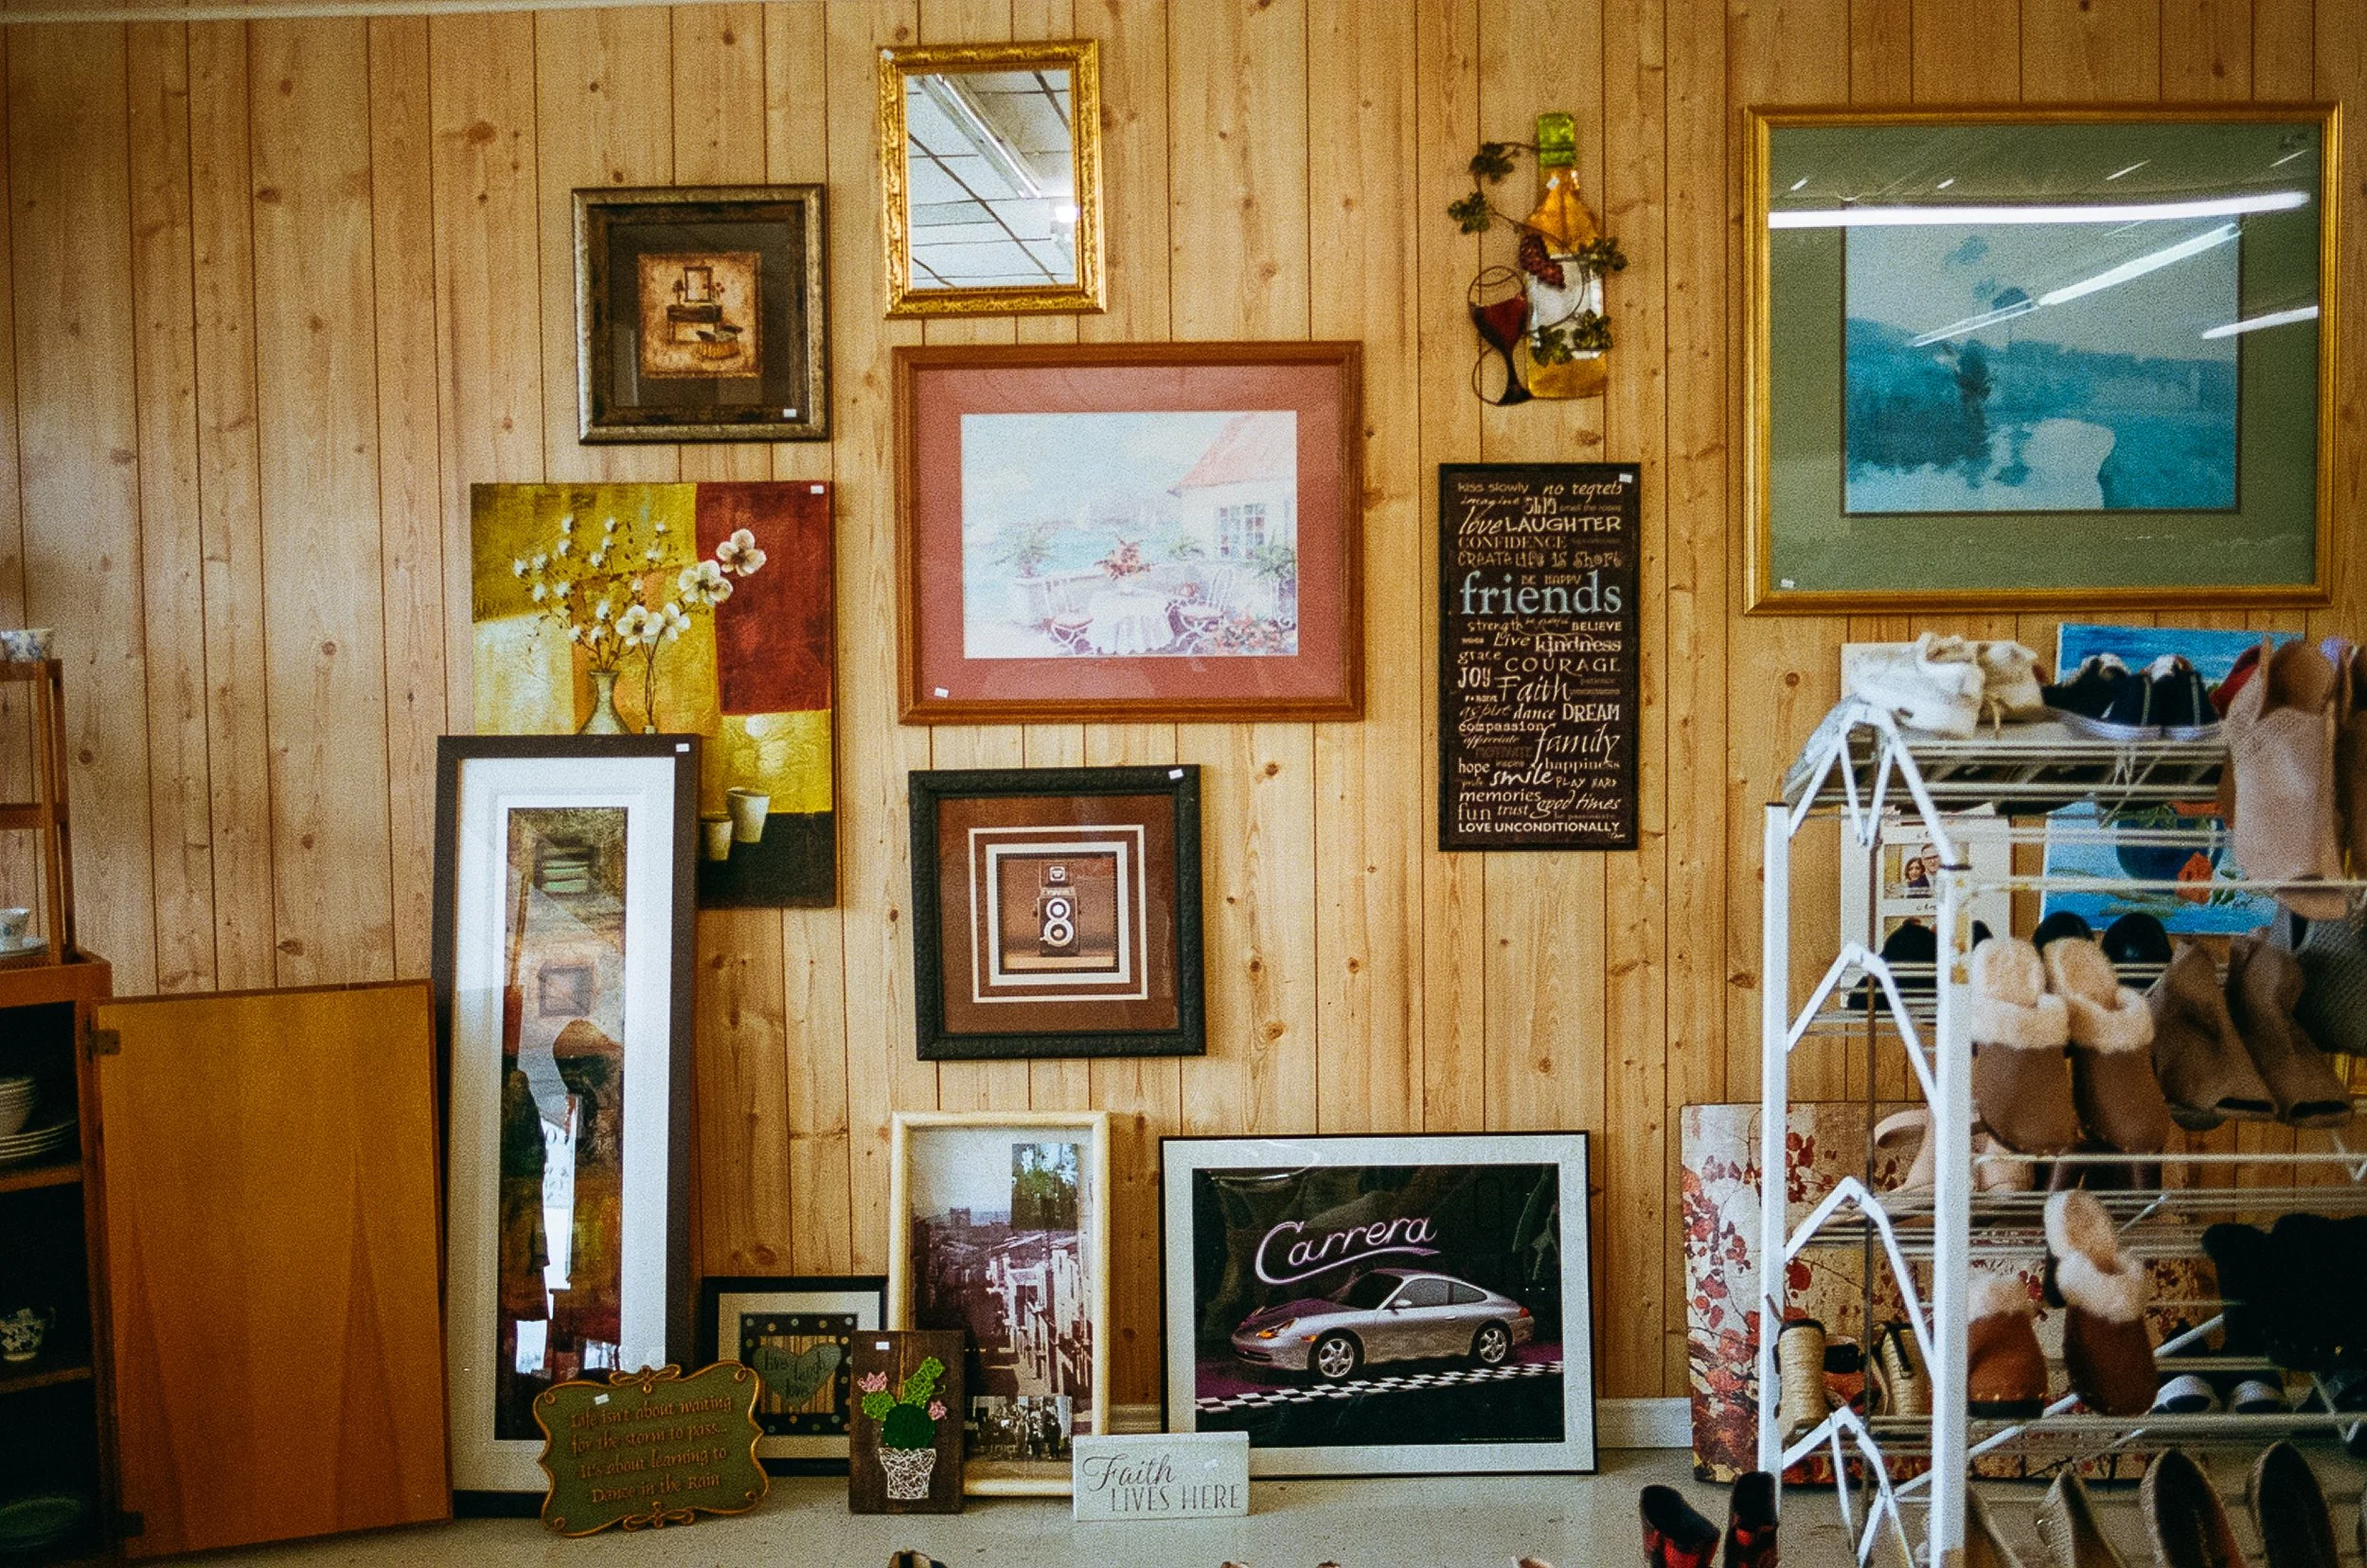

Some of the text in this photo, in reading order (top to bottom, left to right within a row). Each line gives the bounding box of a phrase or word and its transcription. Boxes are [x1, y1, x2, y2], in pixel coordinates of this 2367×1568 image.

[1488, 482, 1529, 493] slowly
[1542, 480, 1623, 504] no regrets
[1504, 516, 1622, 532] LAUGHTER
[1458, 536, 1568, 549] CONFIDENCE
[1544, 574, 1582, 585] HAPPY
[1459, 569, 1623, 615] friends
[1468, 616, 1523, 634] strength
[1572, 620, 1623, 632] BELIEVE
[1493, 632, 1531, 647] Live
[1534, 633, 1623, 657] kindness
[1458, 650, 1502, 664] grace
[1504, 657, 1621, 673] COURAGE
[1494, 673, 1572, 703] Faith
[1513, 703, 1556, 720] dance
[1562, 703, 1621, 722] DREAM
[1458, 721, 1545, 735] compassion
[1530, 722, 1621, 768] family
[1458, 757, 1490, 776] hope
[1545, 757, 1620, 774] happiness
[1489, 763, 1554, 787] smile
[1556, 776, 1586, 789] PLAY
[1459, 789, 1542, 802] memories
[1529, 790, 1575, 819] good
[1458, 803, 1491, 821] fun
[1497, 805, 1529, 815] trust
[1458, 822, 1620, 833] LOVE UNCONDITIONALLY
[1255, 1217, 1440, 1285] Carrera
[635, 1400, 675, 1420] about
[572, 1434, 592, 1455] for
[670, 1426, 683, 1440] to
[651, 1448, 709, 1468] learning
[713, 1447, 726, 1460] to
[1082, 1453, 1176, 1492] Faith
[1111, 1483, 1243, 1512] LIVES HERE
